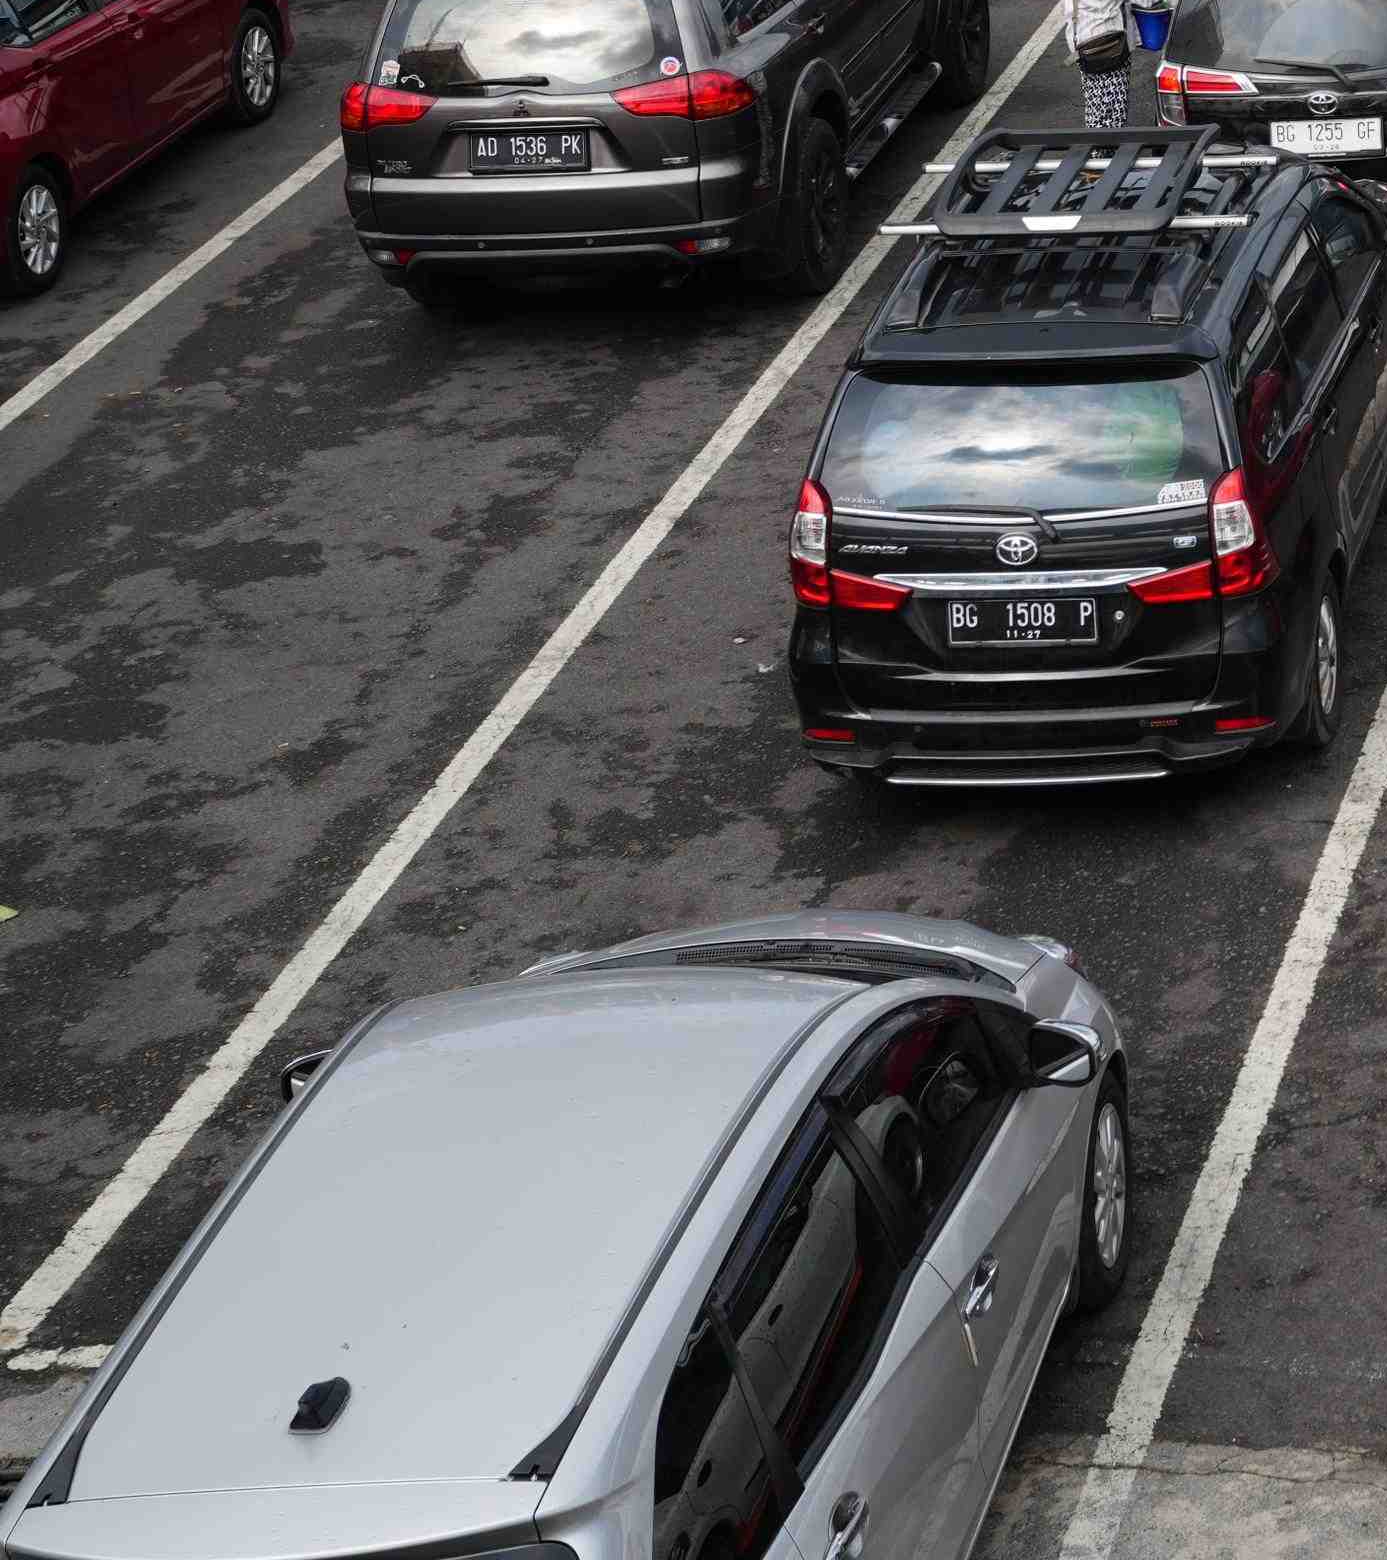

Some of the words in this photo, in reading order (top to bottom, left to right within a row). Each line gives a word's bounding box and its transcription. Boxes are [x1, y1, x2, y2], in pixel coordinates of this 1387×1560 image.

[1276, 126, 1295, 143] BG
[1308, 123, 1344, 141] 1255
[1357, 121, 1376, 139] GF
[477, 136, 498, 157] AD
[510, 135, 547, 157] 1536
[561, 135, 582, 155] PK
[952, 605, 978, 628] BG
[1006, 604, 1056, 627] 1508
[1080, 603, 1093, 626] P
